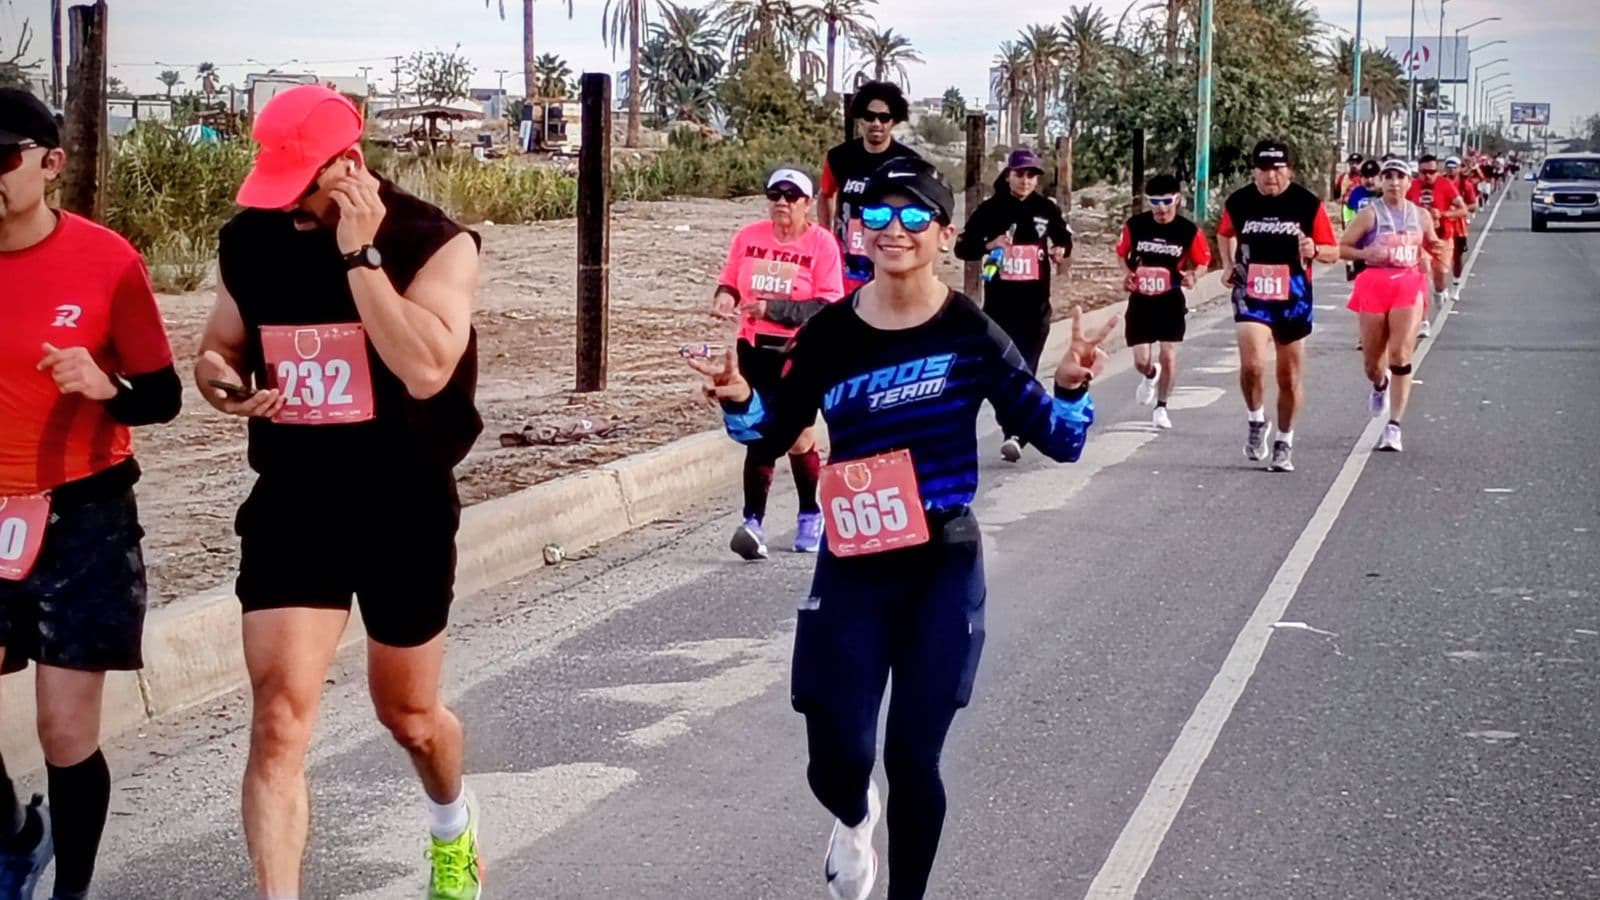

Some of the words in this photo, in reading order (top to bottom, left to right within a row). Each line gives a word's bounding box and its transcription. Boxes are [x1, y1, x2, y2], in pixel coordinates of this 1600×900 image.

[772, 250, 813, 269] TEAM
[752, 275, 792, 294] 1031-1
[1139, 274, 1165, 291] 330
[1254, 276, 1282, 294] 361
[278, 358, 353, 407] 232
[868, 376, 947, 411] TEAM
[831, 487, 909, 540] 665
